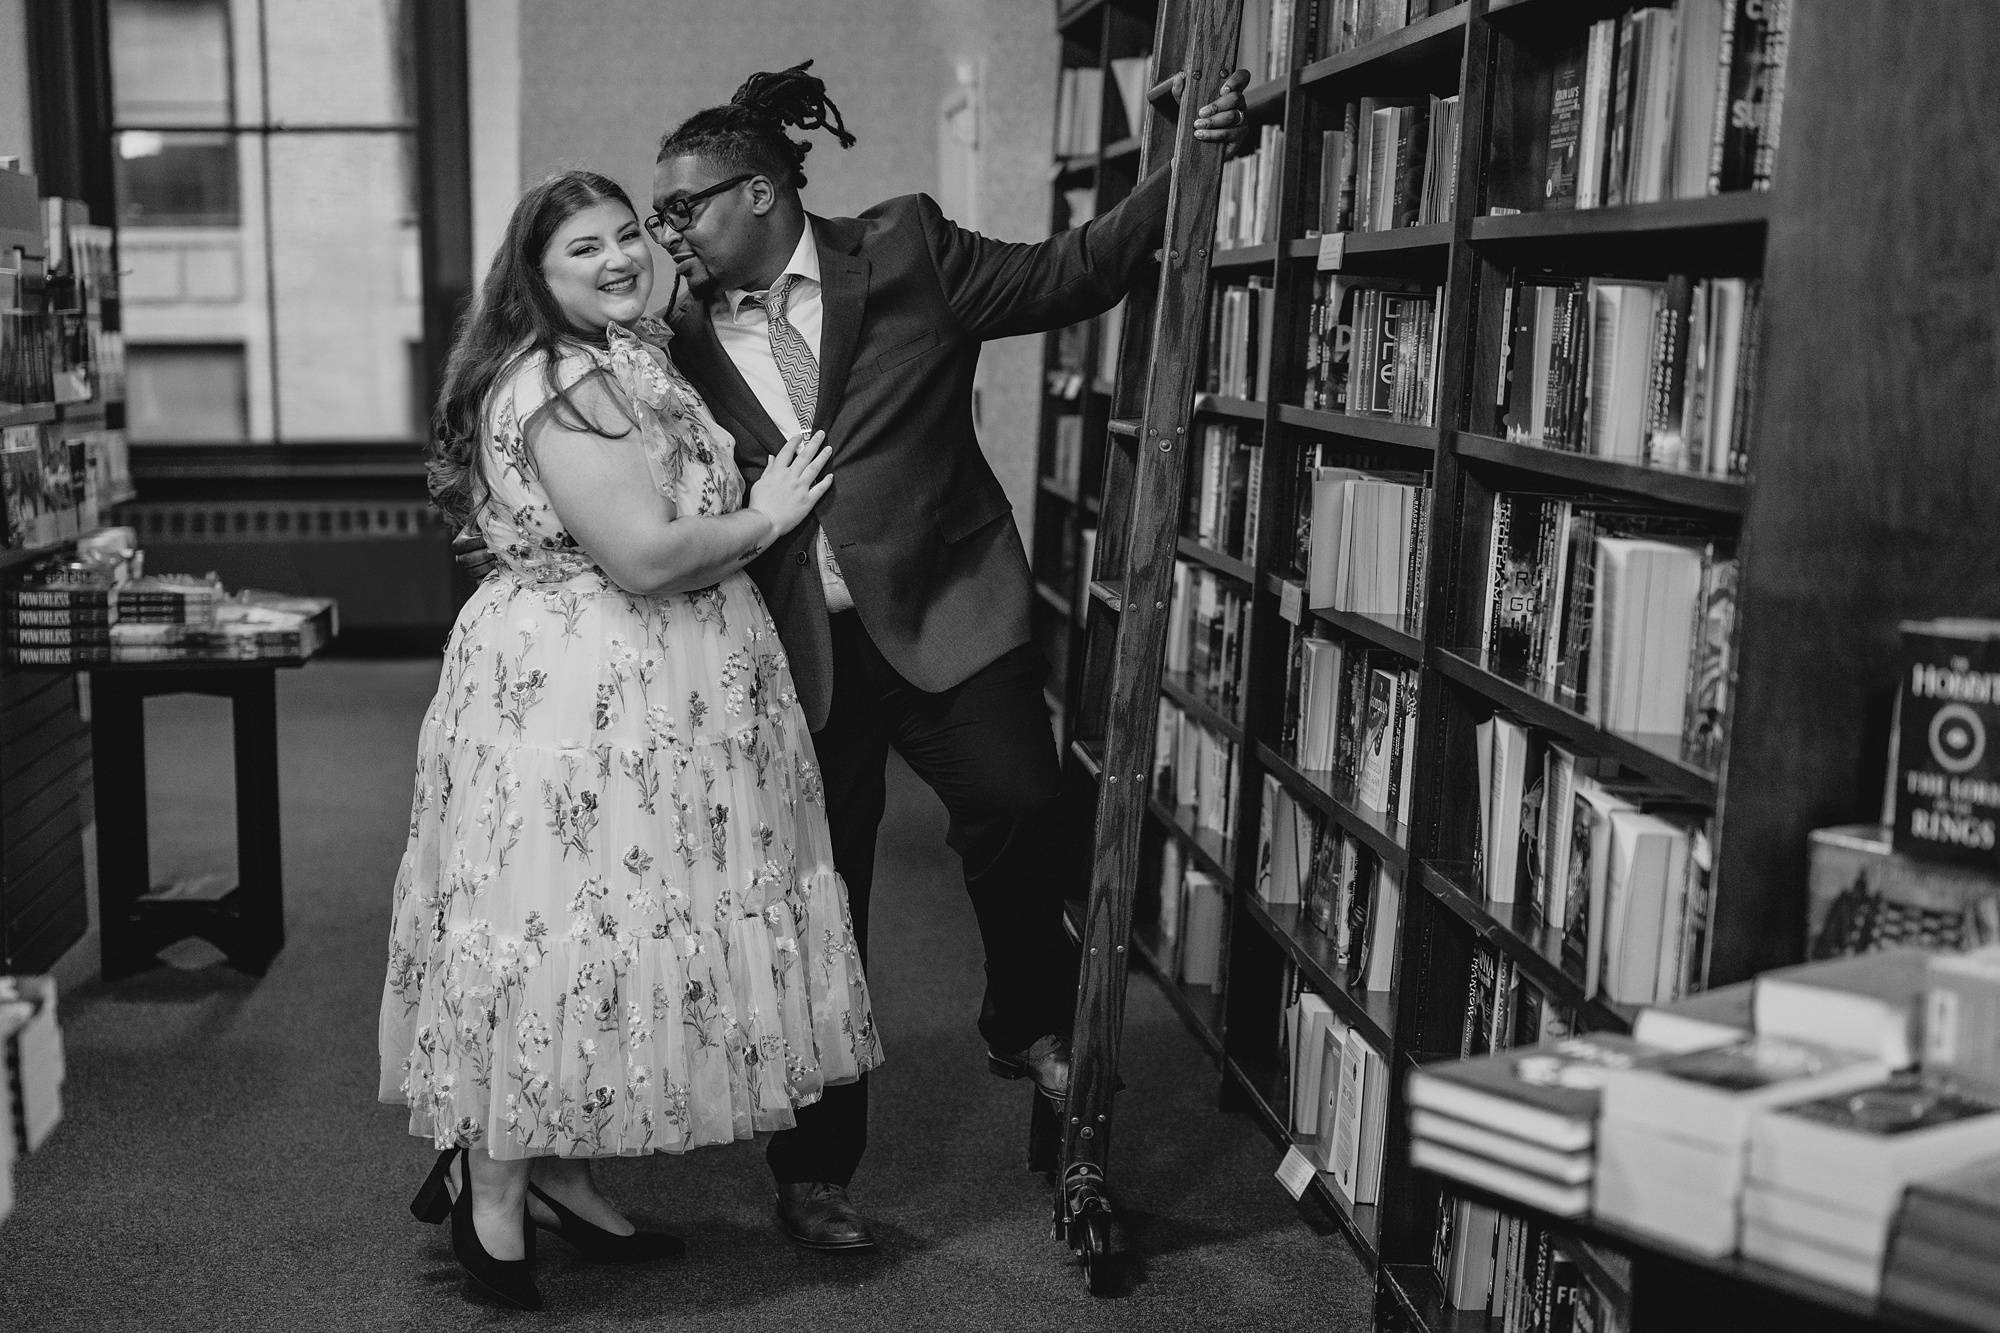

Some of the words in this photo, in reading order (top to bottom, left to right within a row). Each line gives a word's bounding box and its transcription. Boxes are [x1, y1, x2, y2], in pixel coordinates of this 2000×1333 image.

[1563, 292, 1573, 359] NOUMENON
[1493, 508, 1507, 601] GOTHAM
[19, 591, 71, 607] POWERLESS
[19, 610, 71, 626] POWERLESS
[20, 628, 72, 645] POWERLESS
[20, 647, 72, 665] POWERLESS
